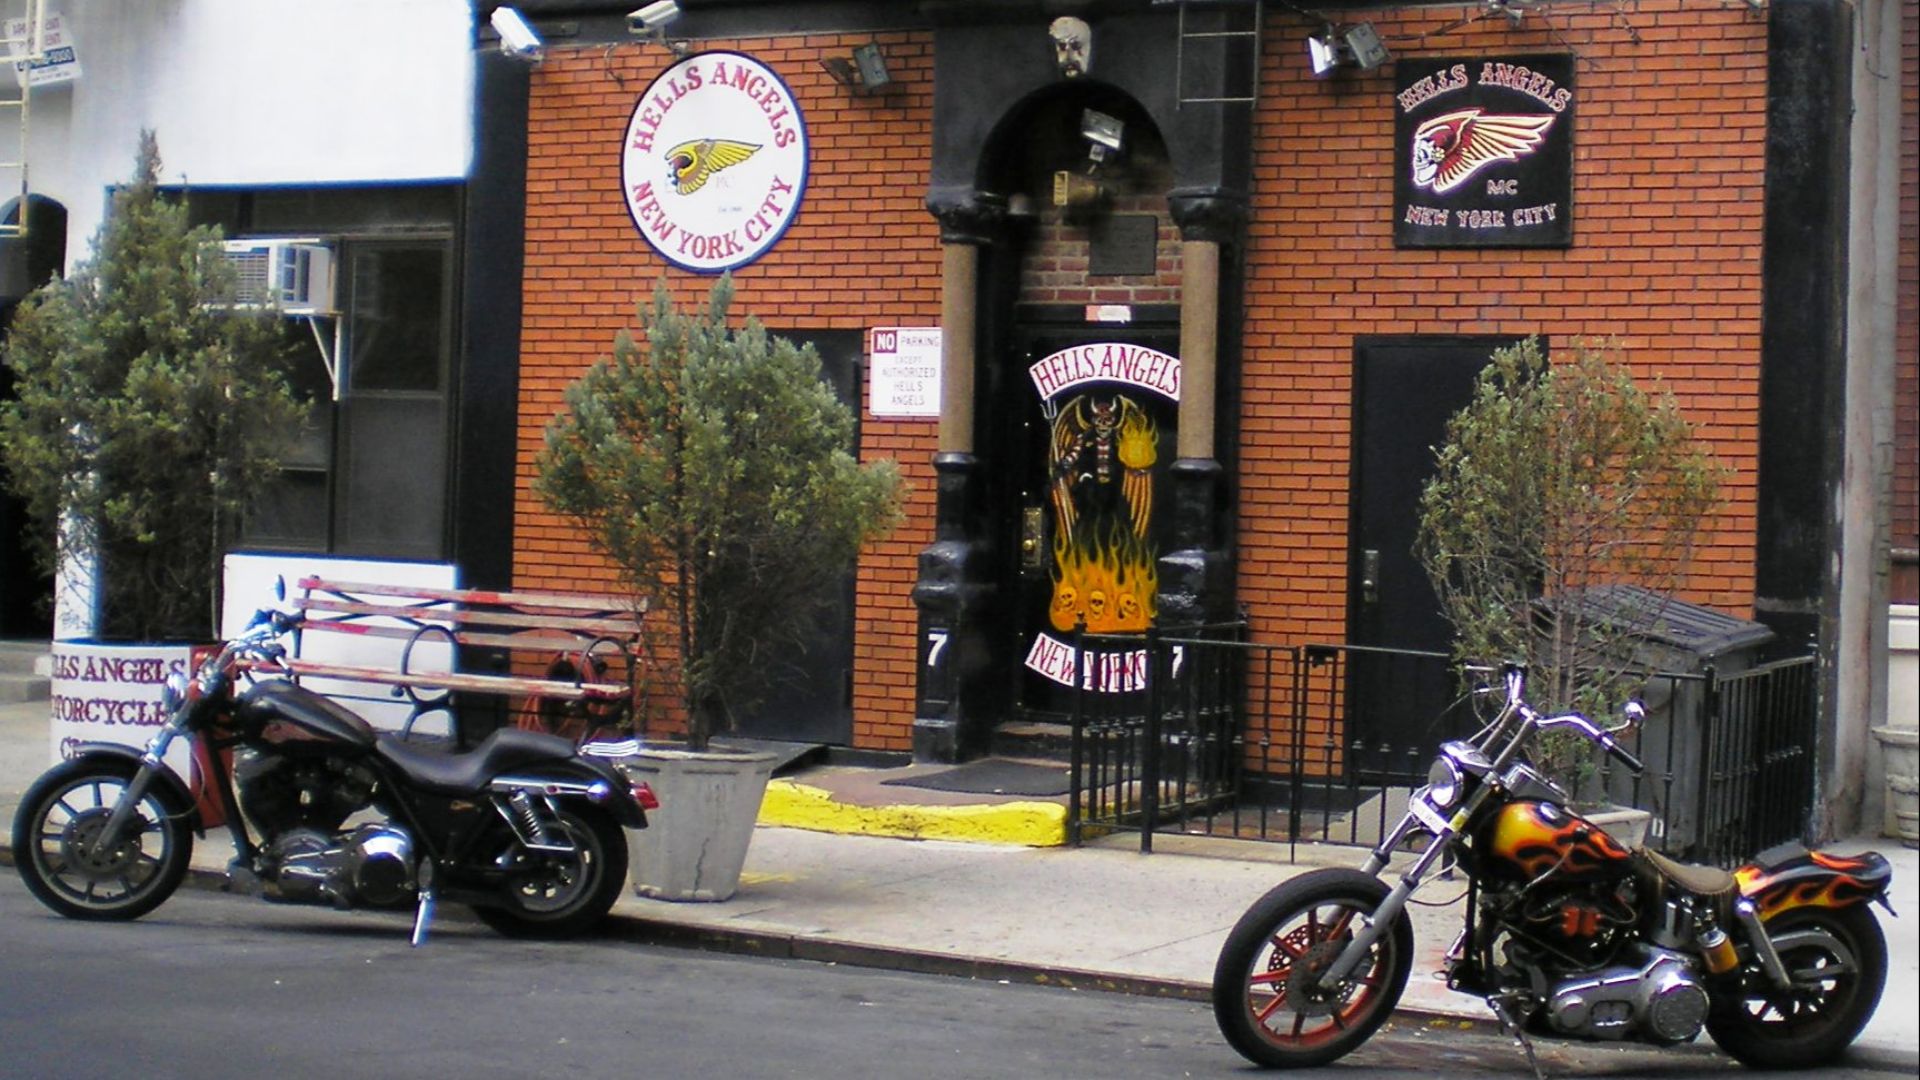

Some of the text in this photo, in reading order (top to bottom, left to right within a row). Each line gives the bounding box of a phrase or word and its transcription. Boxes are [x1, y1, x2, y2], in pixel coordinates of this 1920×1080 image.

[1397, 62, 1572, 113] HELLS ANGELS
[632, 61, 796, 153] HELLS ANGELS
[1486, 179, 1518, 195] MC
[633, 174, 793, 259] NEW YORK CITY
[1404, 203, 1557, 228] NEW YORK CITY
[877, 333, 895, 351] NO
[1033, 345, 1180, 396] HELLS ANGELS
[891, 395, 925, 406] ANGELS
[928, 633, 947, 666] 7
[1030, 636, 1076, 682] NEW
[81, 657, 185, 685] ANGELS
